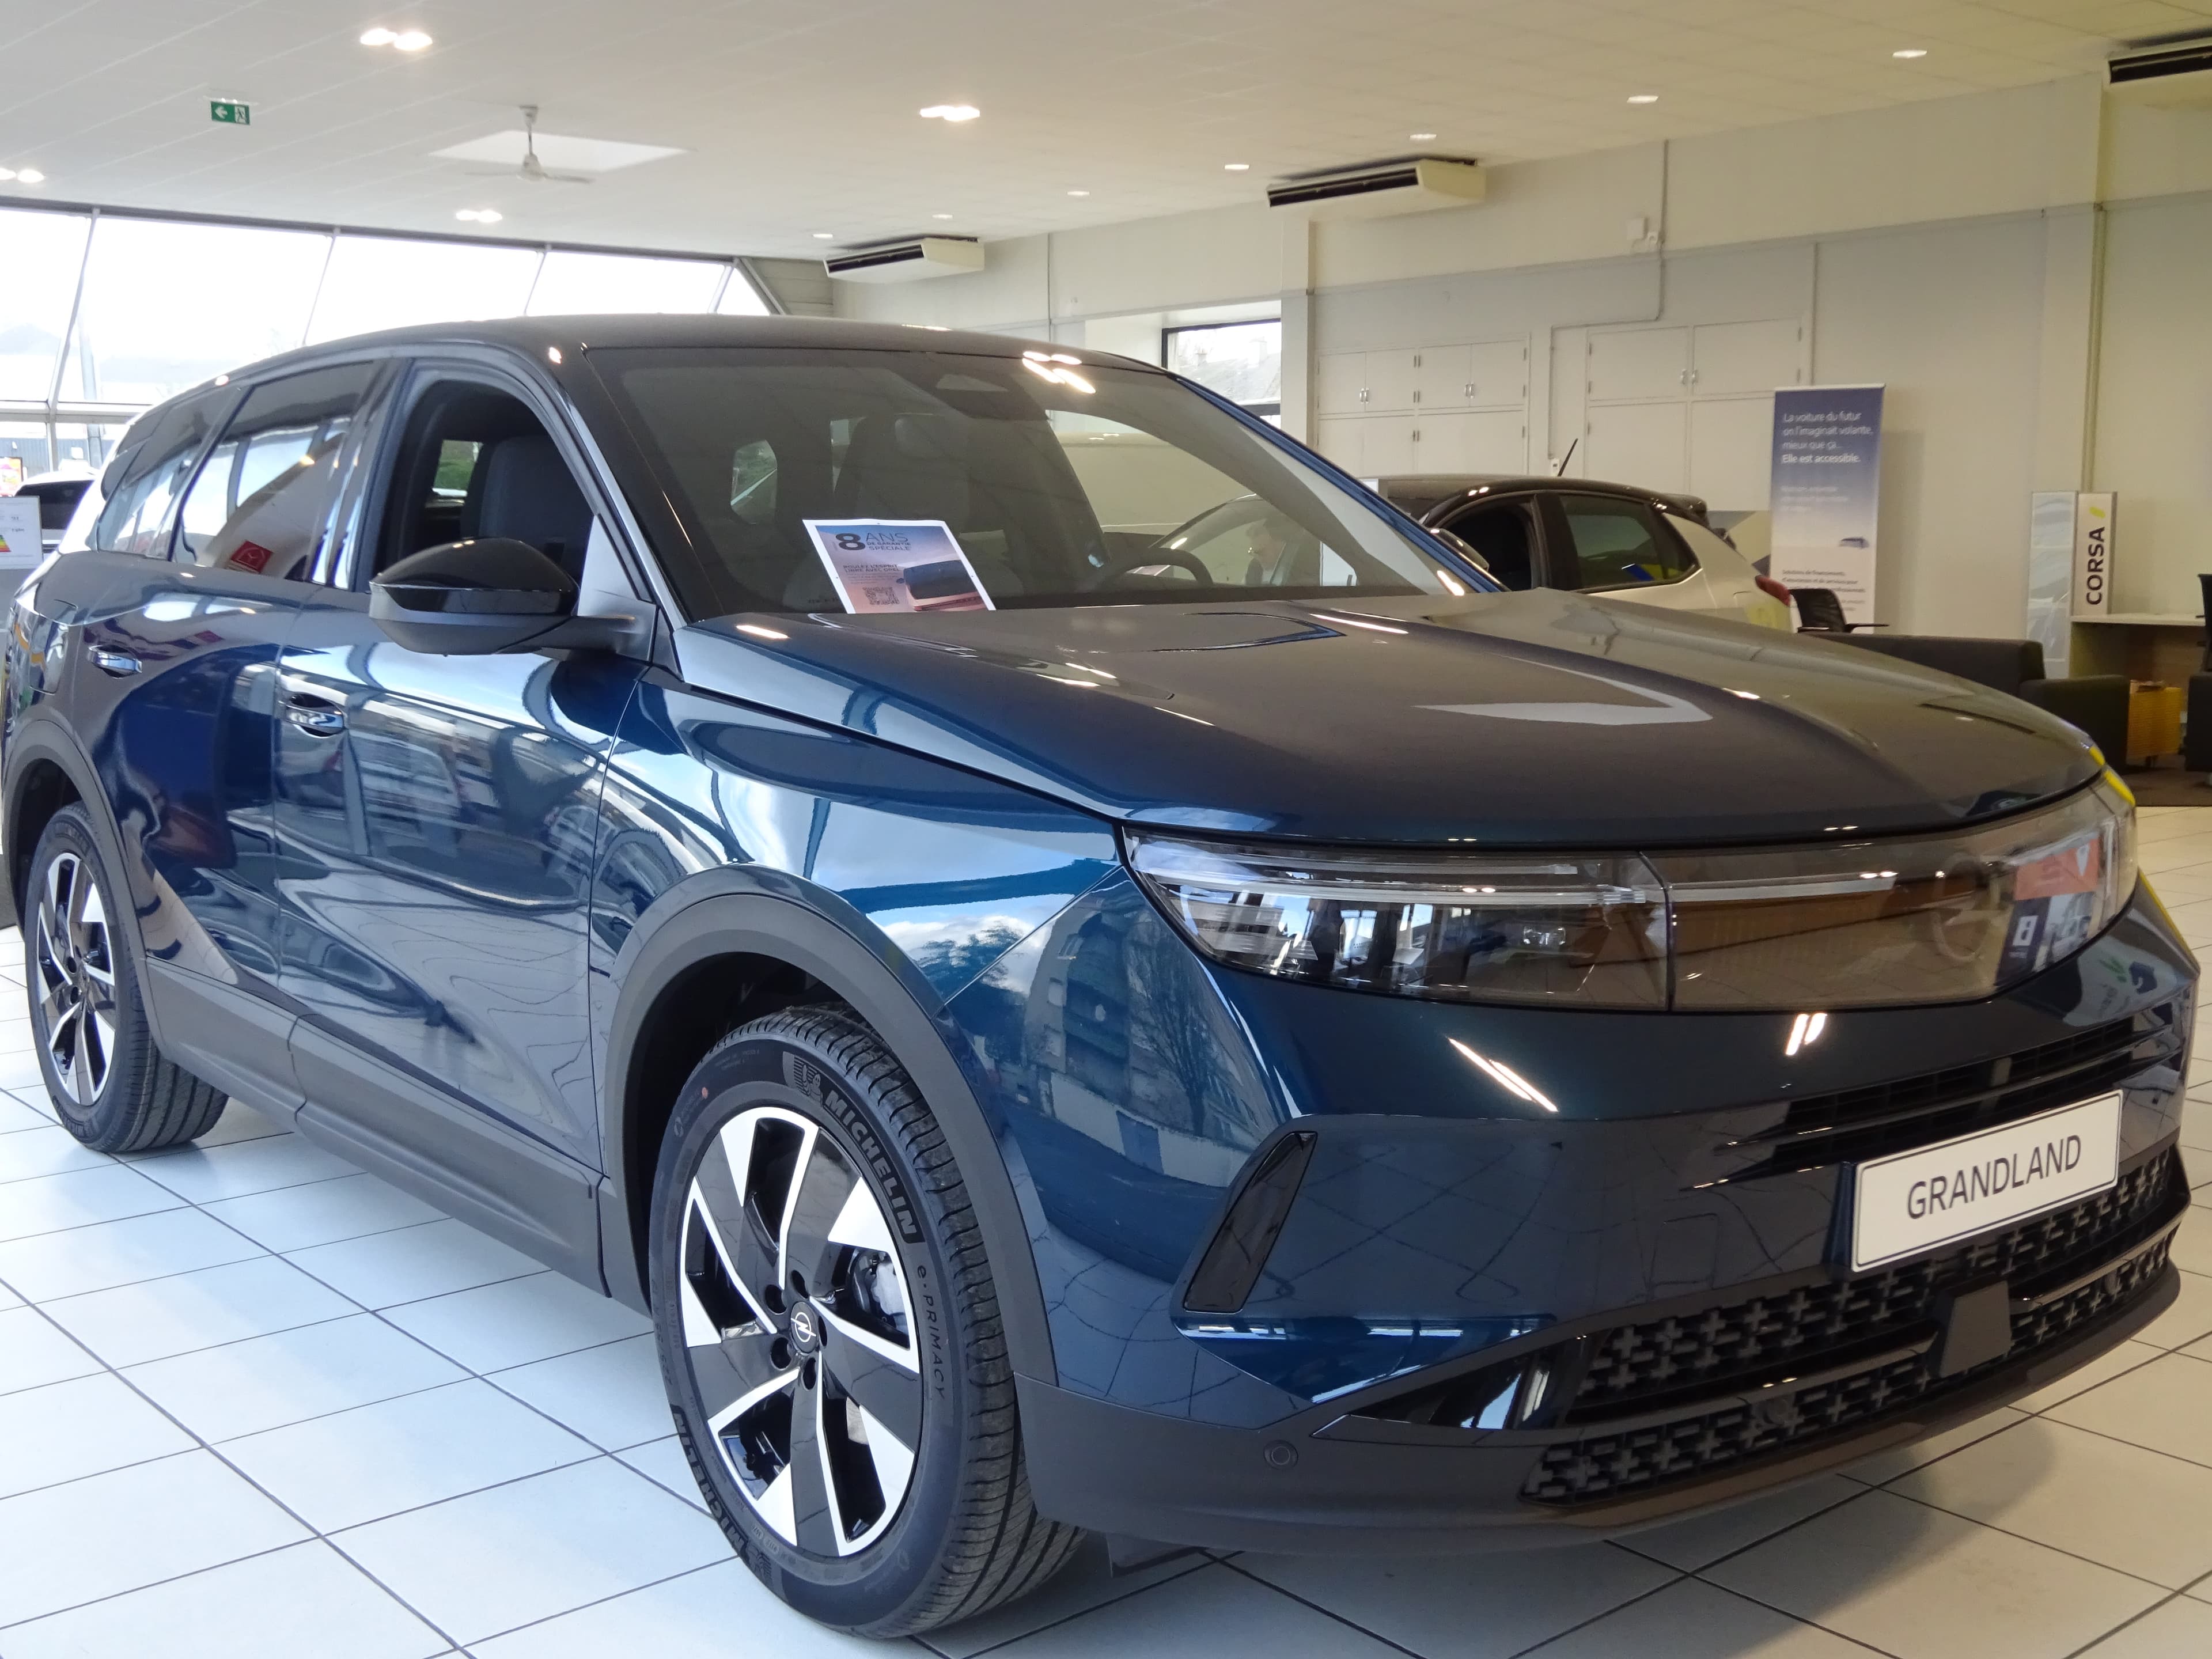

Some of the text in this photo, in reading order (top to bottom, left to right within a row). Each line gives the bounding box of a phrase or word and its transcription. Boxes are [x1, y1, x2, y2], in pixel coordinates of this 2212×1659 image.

[1783, 411, 1862, 422] La voiture du futur
[1783, 453, 1798, 463] Elle
[1800, 454, 1813, 463] est
[835, 532, 908, 551] 8 ANS
[2086, 526, 2105, 605] CORSA
[825, 1090, 917, 1234] MICHELIN
[1907, 1134, 2082, 1220] GRANDLAND
